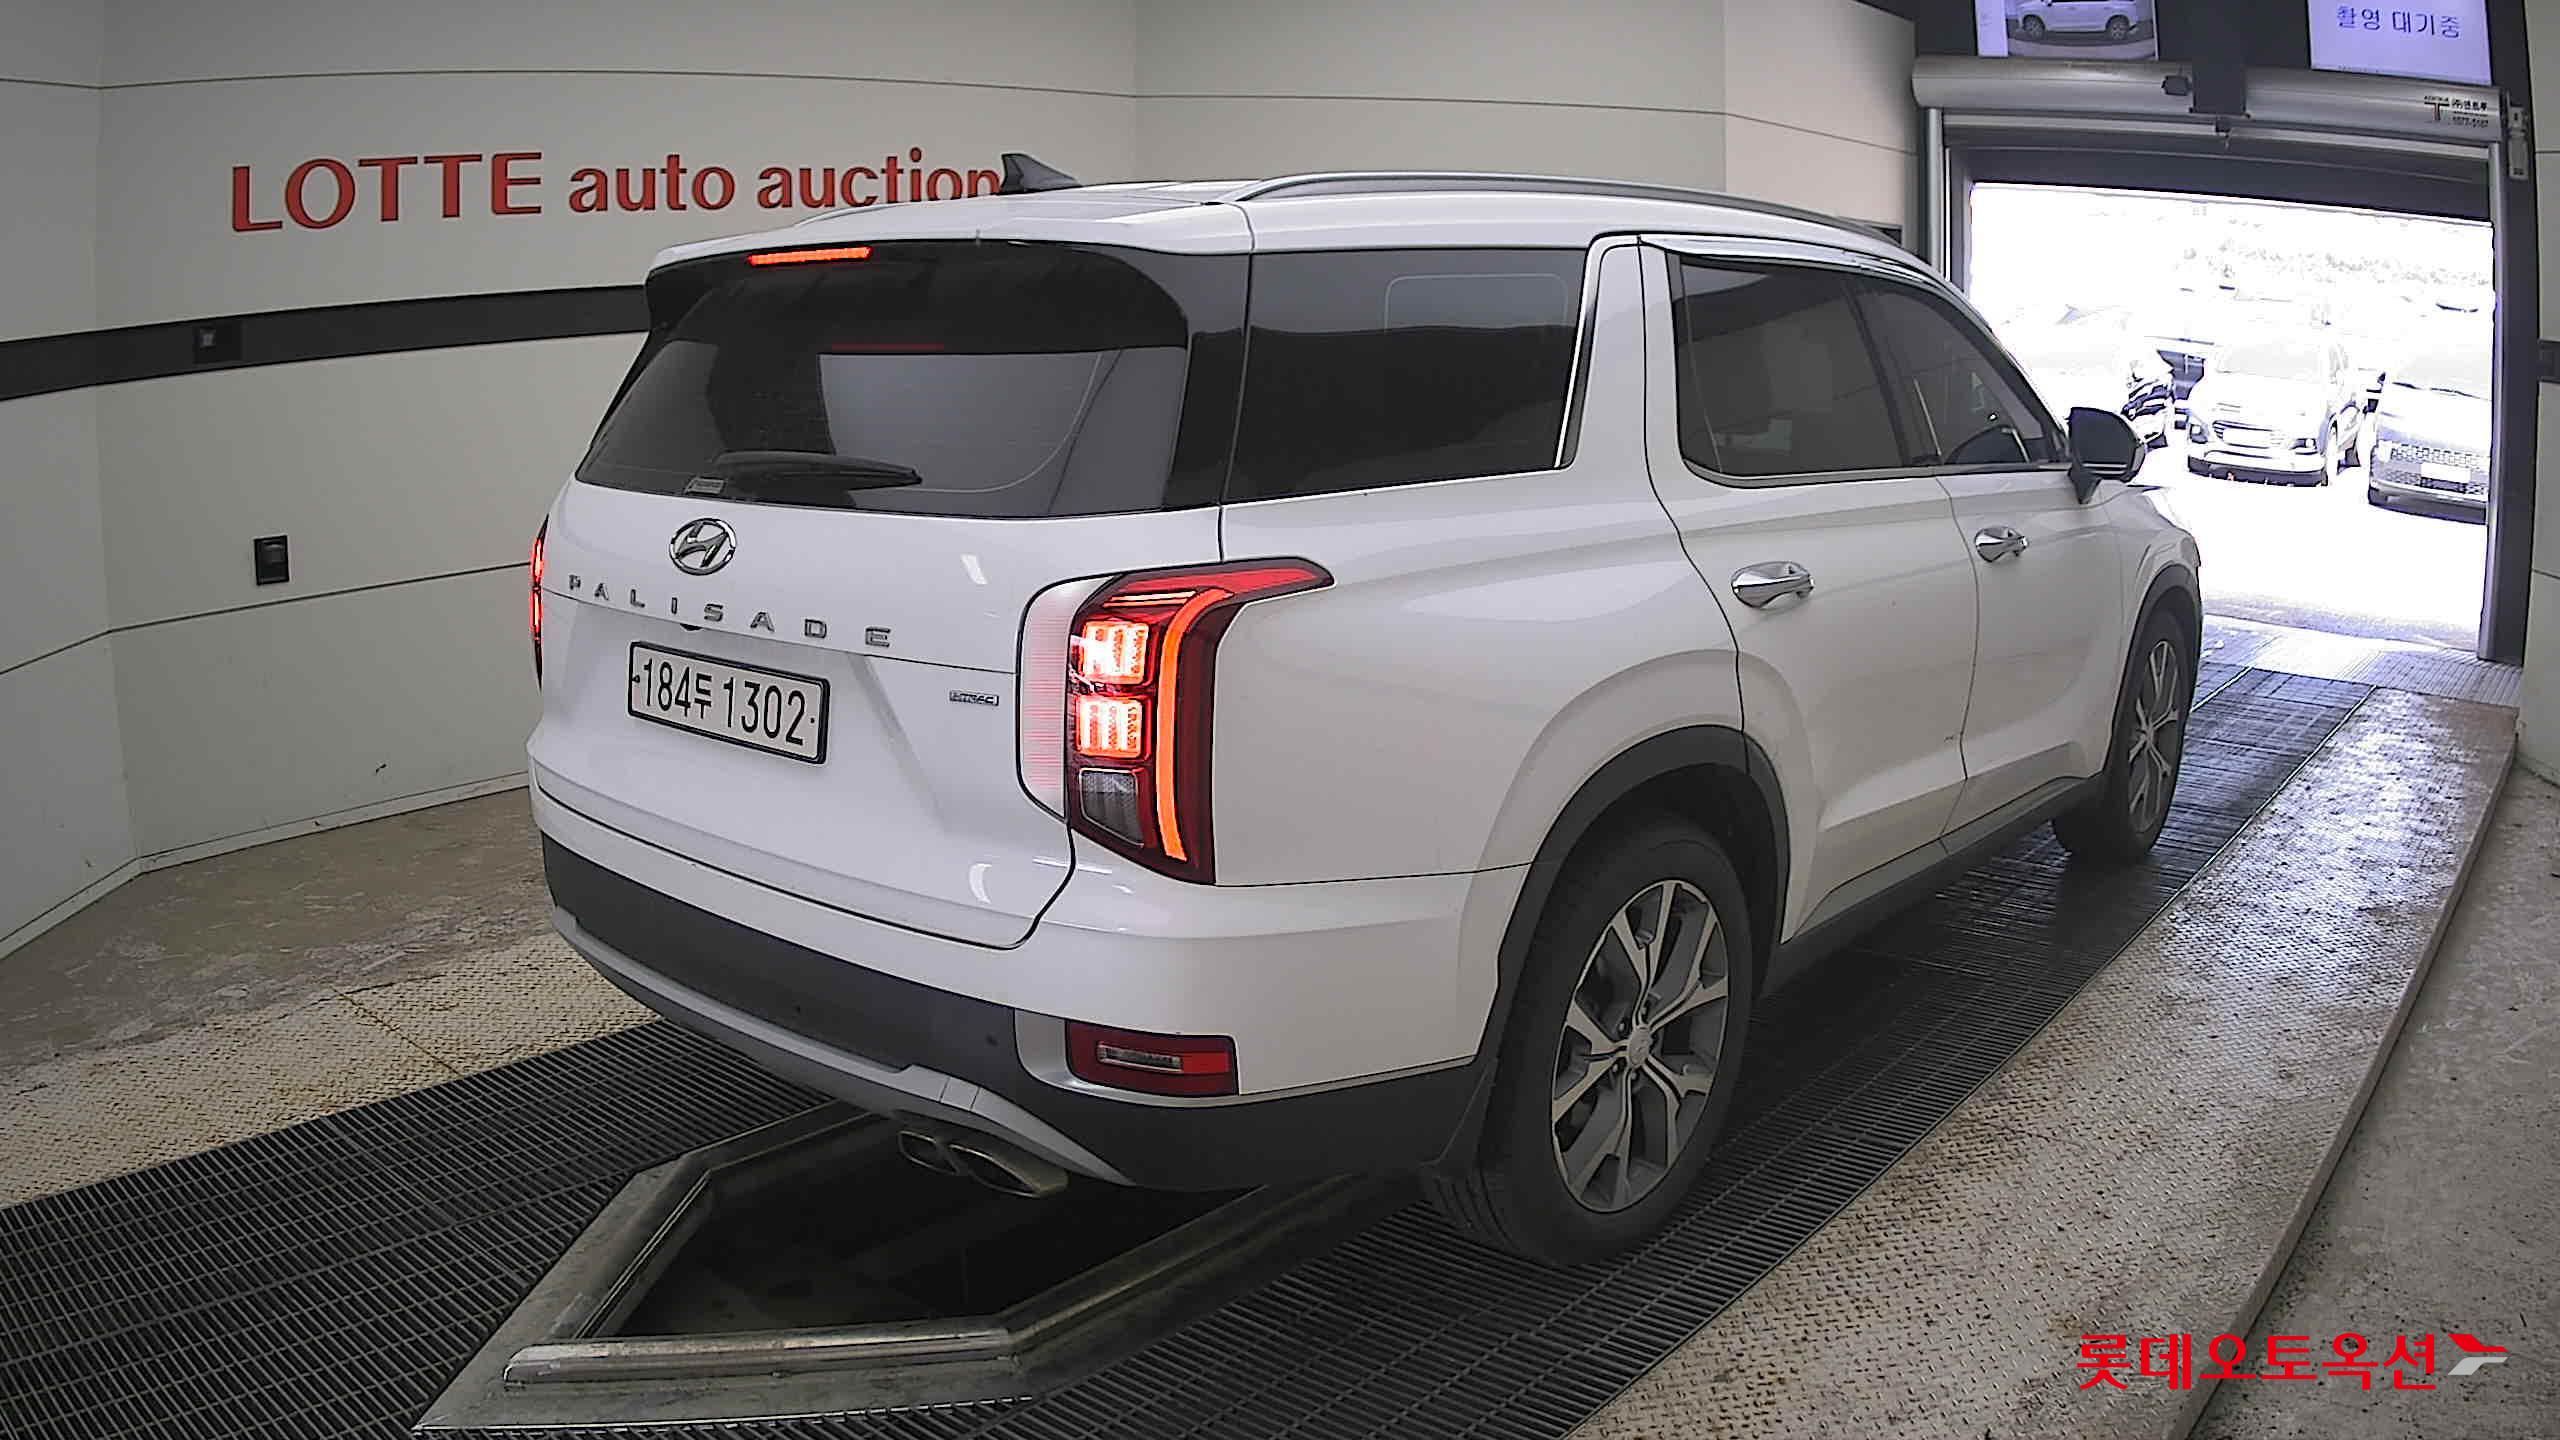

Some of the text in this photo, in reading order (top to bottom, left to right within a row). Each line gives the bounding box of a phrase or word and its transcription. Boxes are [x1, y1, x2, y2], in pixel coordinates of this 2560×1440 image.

[2392, 10, 2459, 39] 대기중
[231, 147, 1002, 234] LOTTE auto auction
[567, 574, 892, 648] PALISADE
[642, 656, 808, 746] 184두 1302
